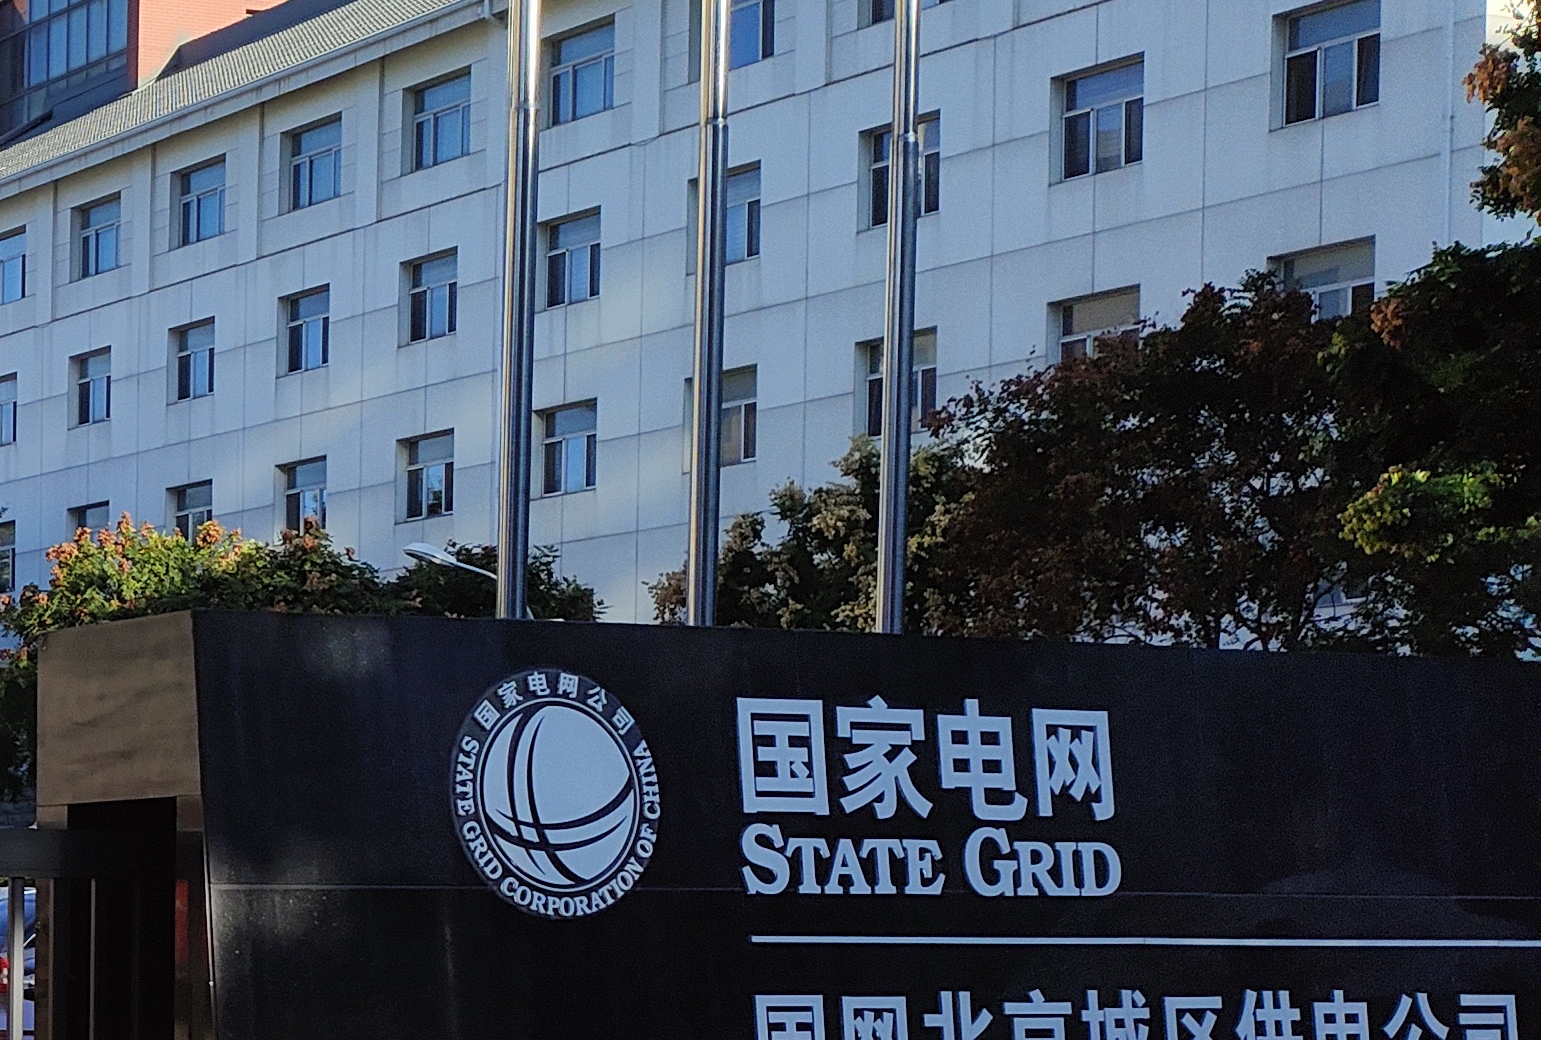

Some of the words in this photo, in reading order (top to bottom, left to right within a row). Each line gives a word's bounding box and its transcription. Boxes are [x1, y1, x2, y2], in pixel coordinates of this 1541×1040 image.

[473, 671, 636, 735] 国家电网公司
[455, 736, 480, 816] STATE
[633, 739, 661, 820] CHINA
[736, 694, 1116, 822] 国家电网
[463, 820, 503, 880] GRID
[635, 823, 658, 858] OF
[741, 823, 946, 895] STATE
[964, 827, 1122, 897] GRID
[501, 856, 644, 917] CORPORATION
